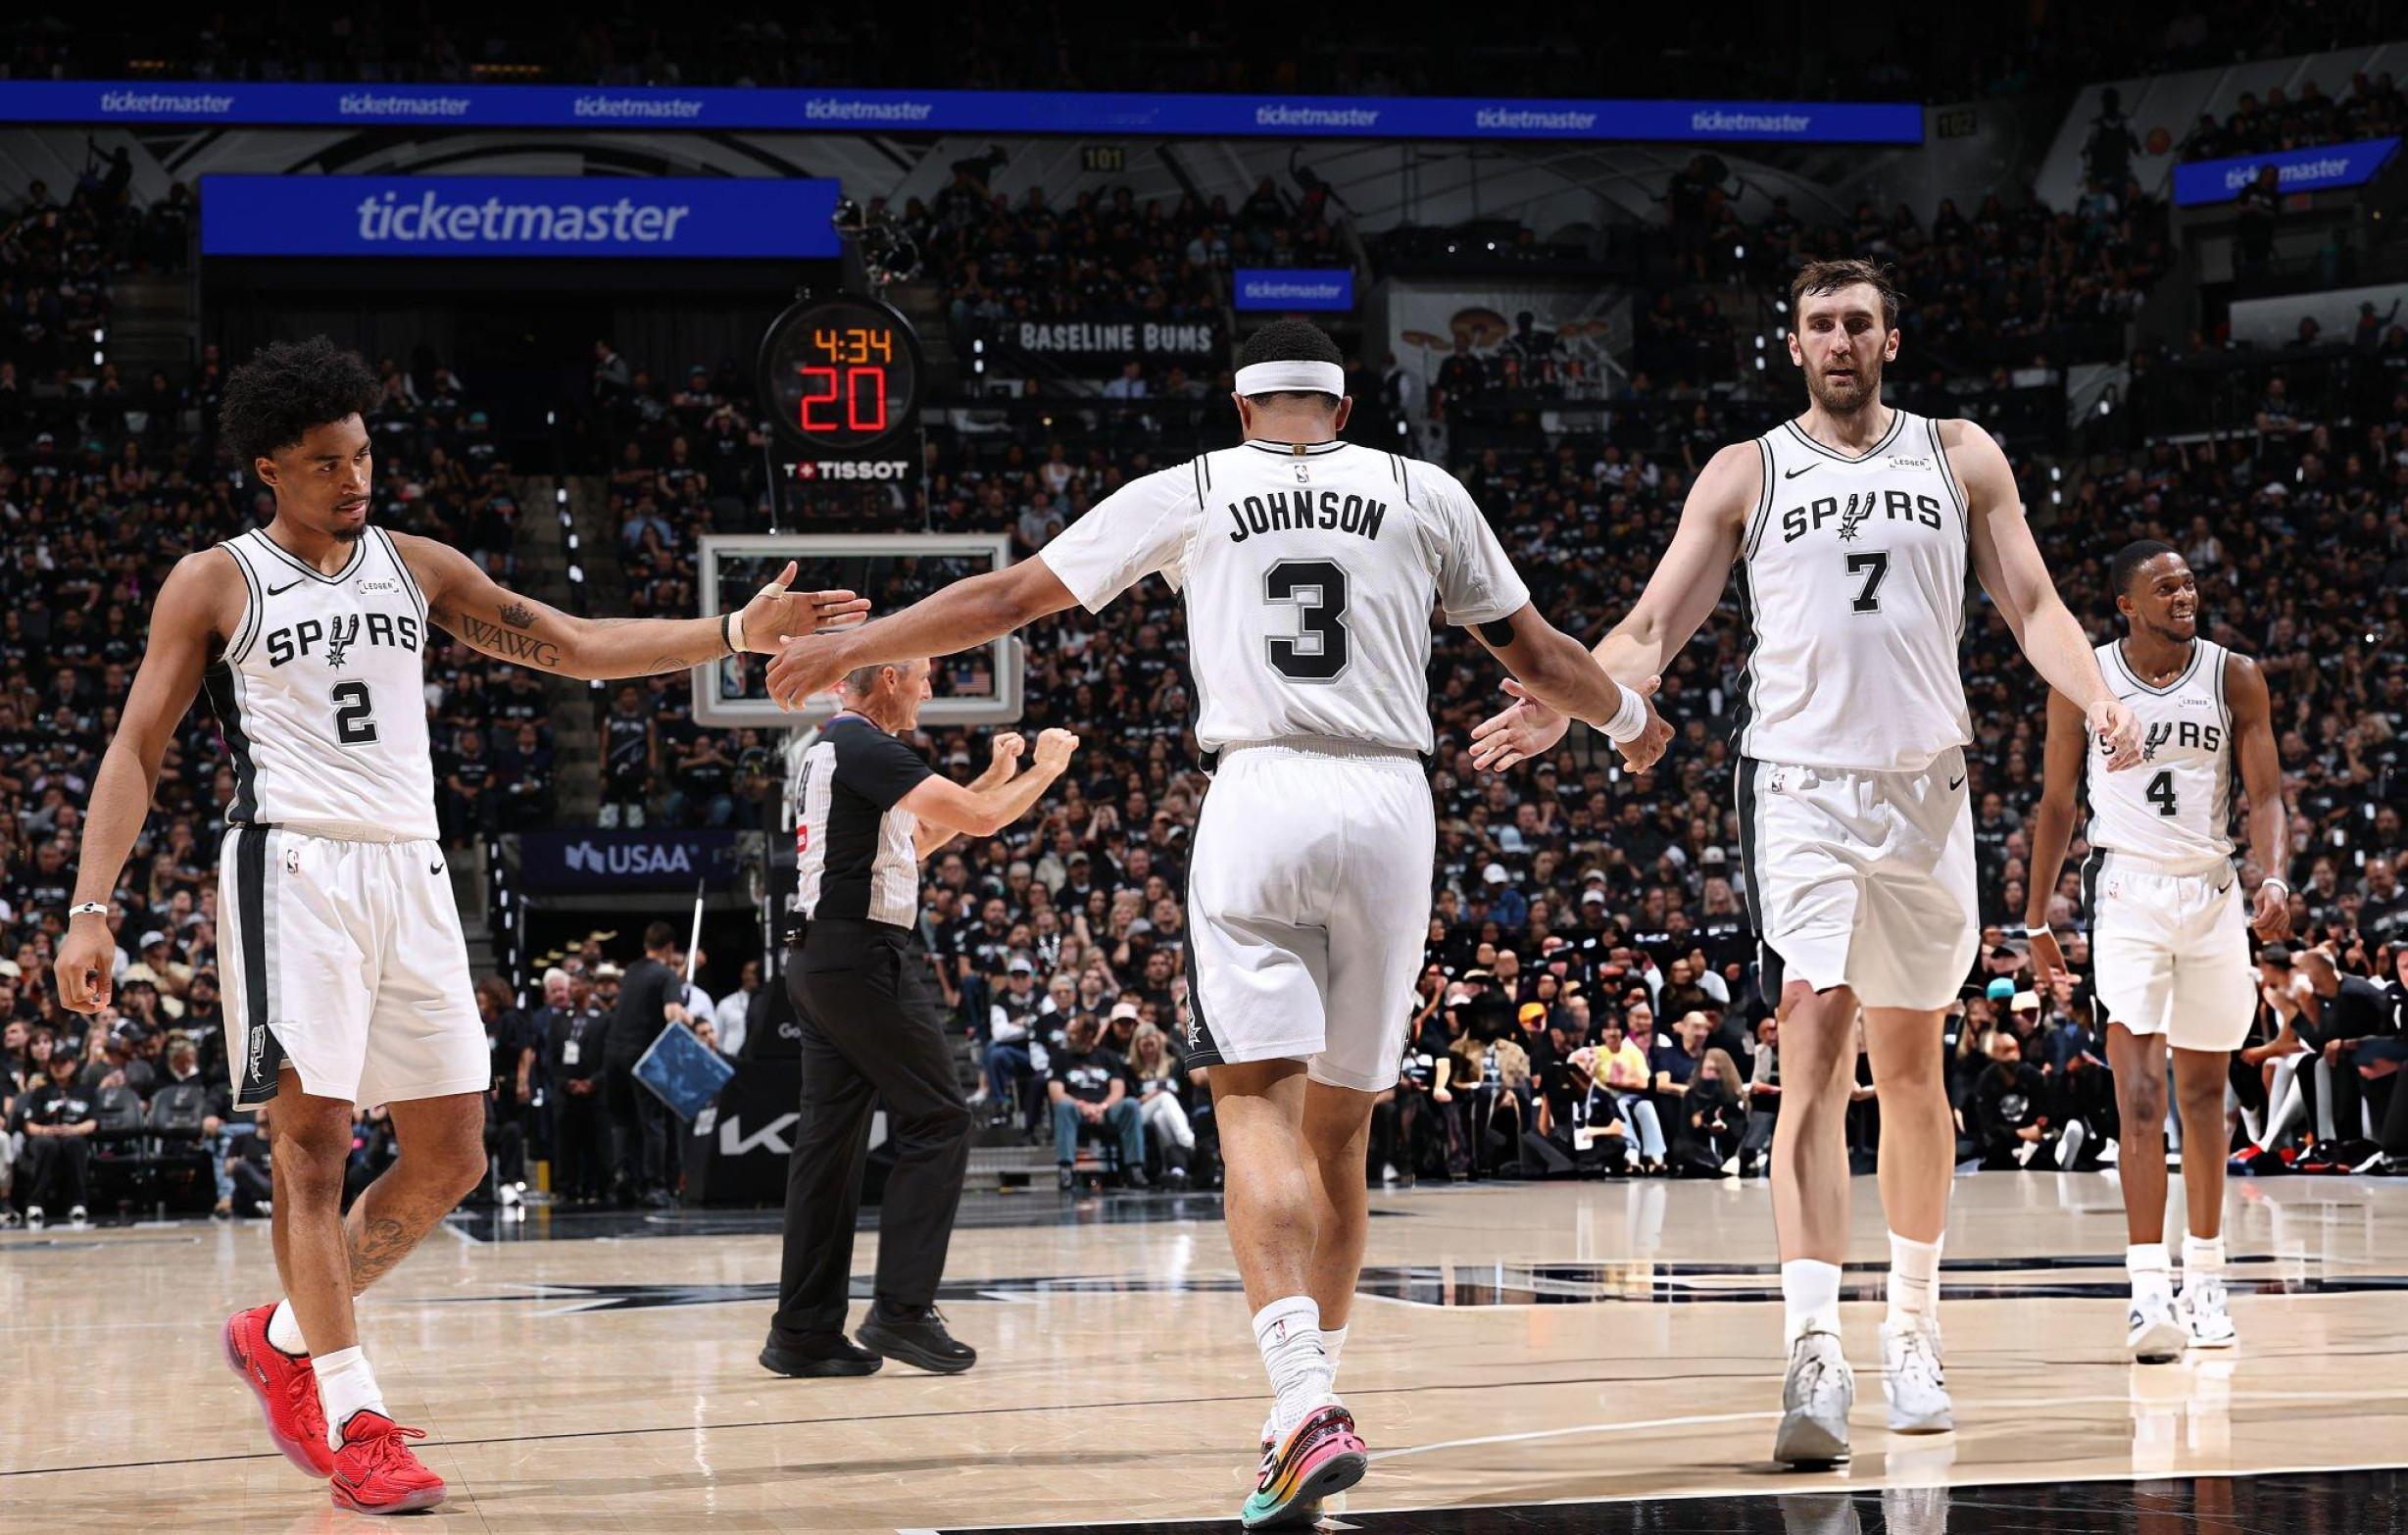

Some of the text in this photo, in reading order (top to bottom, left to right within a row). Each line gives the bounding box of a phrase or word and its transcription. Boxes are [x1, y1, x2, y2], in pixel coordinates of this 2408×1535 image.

[101, 91, 234, 114] ticketmaster
[340, 93, 470, 116] ticketmaster
[574, 95, 703, 119] ticketmaster
[806, 98, 932, 122] ticketmaster
[1255, 104, 1380, 127] ticketmaster
[1476, 107, 1597, 130] ticketmaster
[1692, 110, 1811, 133] ticketmaster
[1085, 148, 1123, 172] 101
[358, 190, 690, 243] ticketmaster
[1245, 280, 1343, 300] ticketmaster
[814, 328, 893, 364] 4:34
[799, 367, 888, 430] 20
[816, 461, 910, 480] TISSOT
[1229, 490, 1388, 543] JOHNSON
[1783, 490, 1942, 543] SPURS
[1843, 550, 1892, 616] 7
[1262, 558, 1351, 684] 3
[266, 612, 416, 670] SPURS
[460, 612, 561, 668] WAWG
[330, 678, 381, 748] 2
[2099, 721, 2222, 764] SURS
[2143, 768, 2180, 818] 4
[608, 844, 692, 874] USAA
